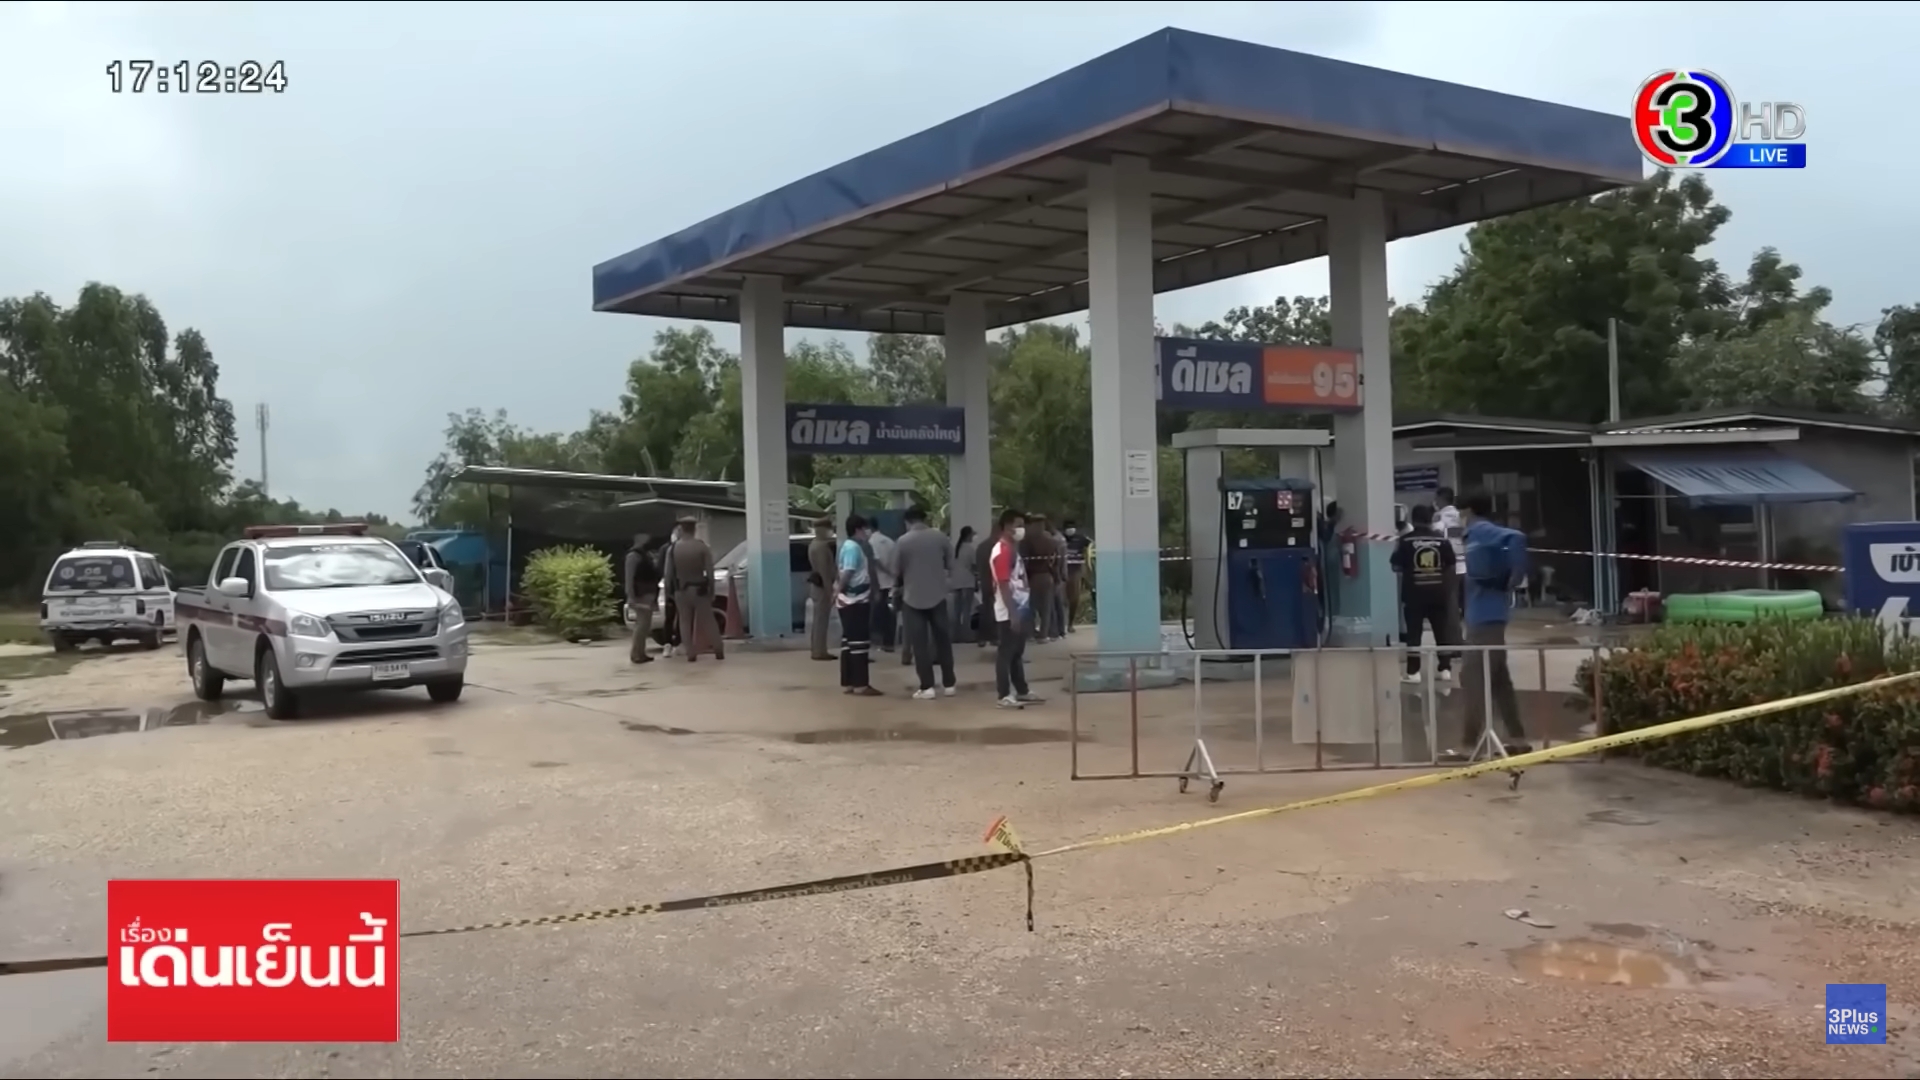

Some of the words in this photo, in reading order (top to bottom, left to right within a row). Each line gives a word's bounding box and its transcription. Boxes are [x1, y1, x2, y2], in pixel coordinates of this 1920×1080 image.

[1171, 346, 1253, 395] ดีเซล
[1313, 361, 1355, 398] 95
[791, 409, 870, 445] ดีเซล
[369, 612, 405, 622] ISUZU
